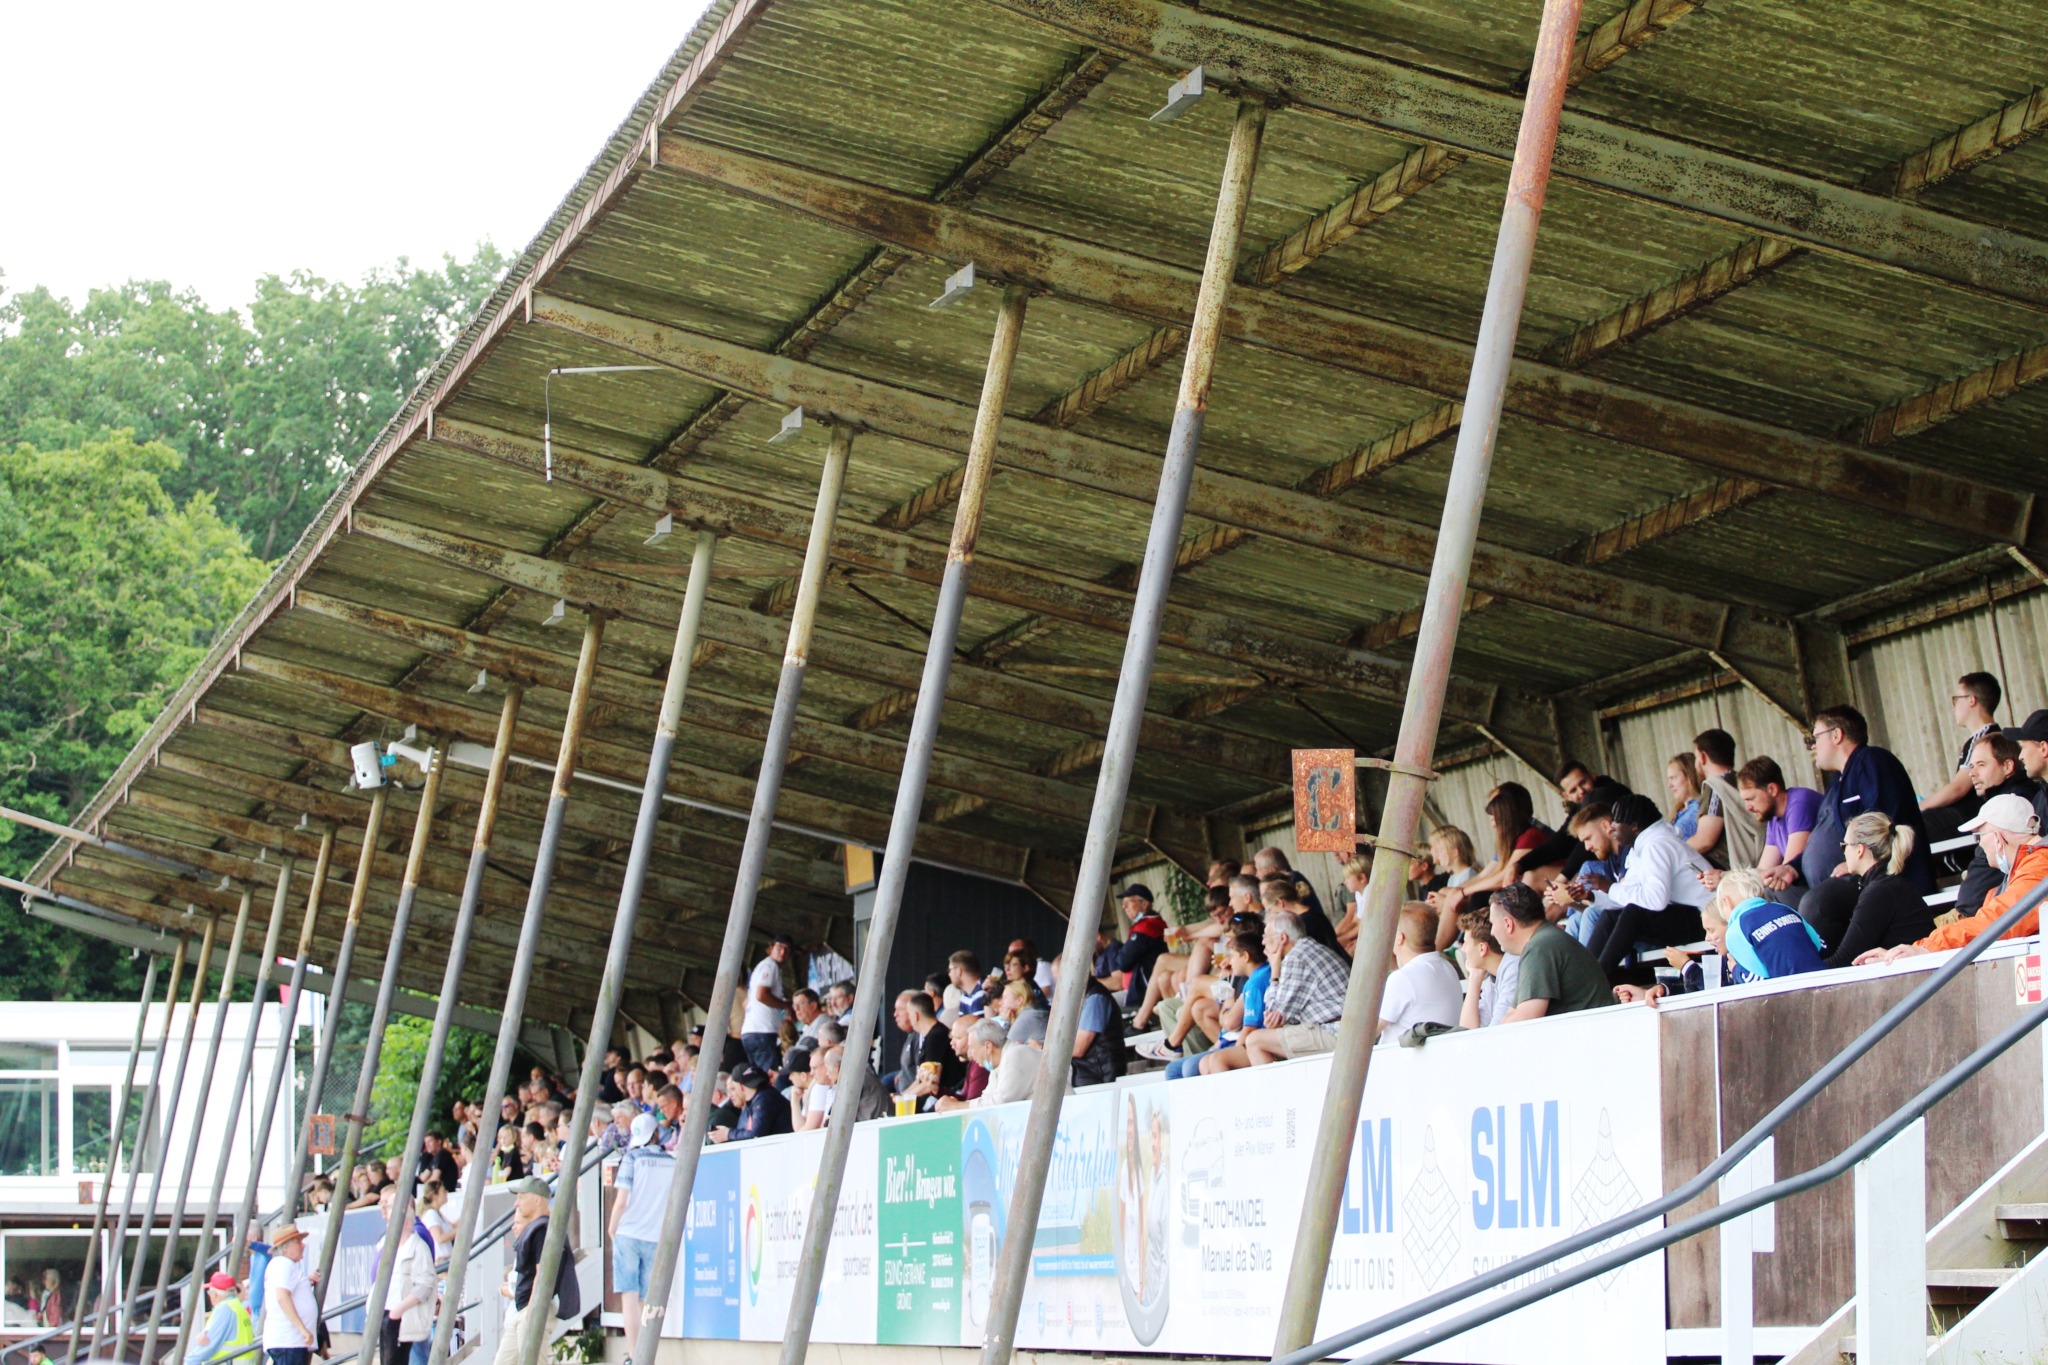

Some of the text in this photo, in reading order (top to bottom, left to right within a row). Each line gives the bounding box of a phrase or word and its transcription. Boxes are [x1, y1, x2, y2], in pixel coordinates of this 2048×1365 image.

[1751, 921, 1778, 942] TENNIS
[314, 1122, 329, 1146] B
[641, 1159, 657, 1168] FIJI
[1342, 1117, 1394, 1235] LM
[1471, 1100, 1560, 1230] SLM
[885, 1154, 956, 1209] Bier?! Bringen wir.
[764, 1197, 802, 1241] hattrick.de
[833, 1190, 873, 1236] attrick.de
[1202, 1198, 1267, 1229] AUTOHANDEL
[1201, 1242, 1272, 1272] Manuel da Silva
[1327, 1257, 1395, 1290] OLUTIONS
